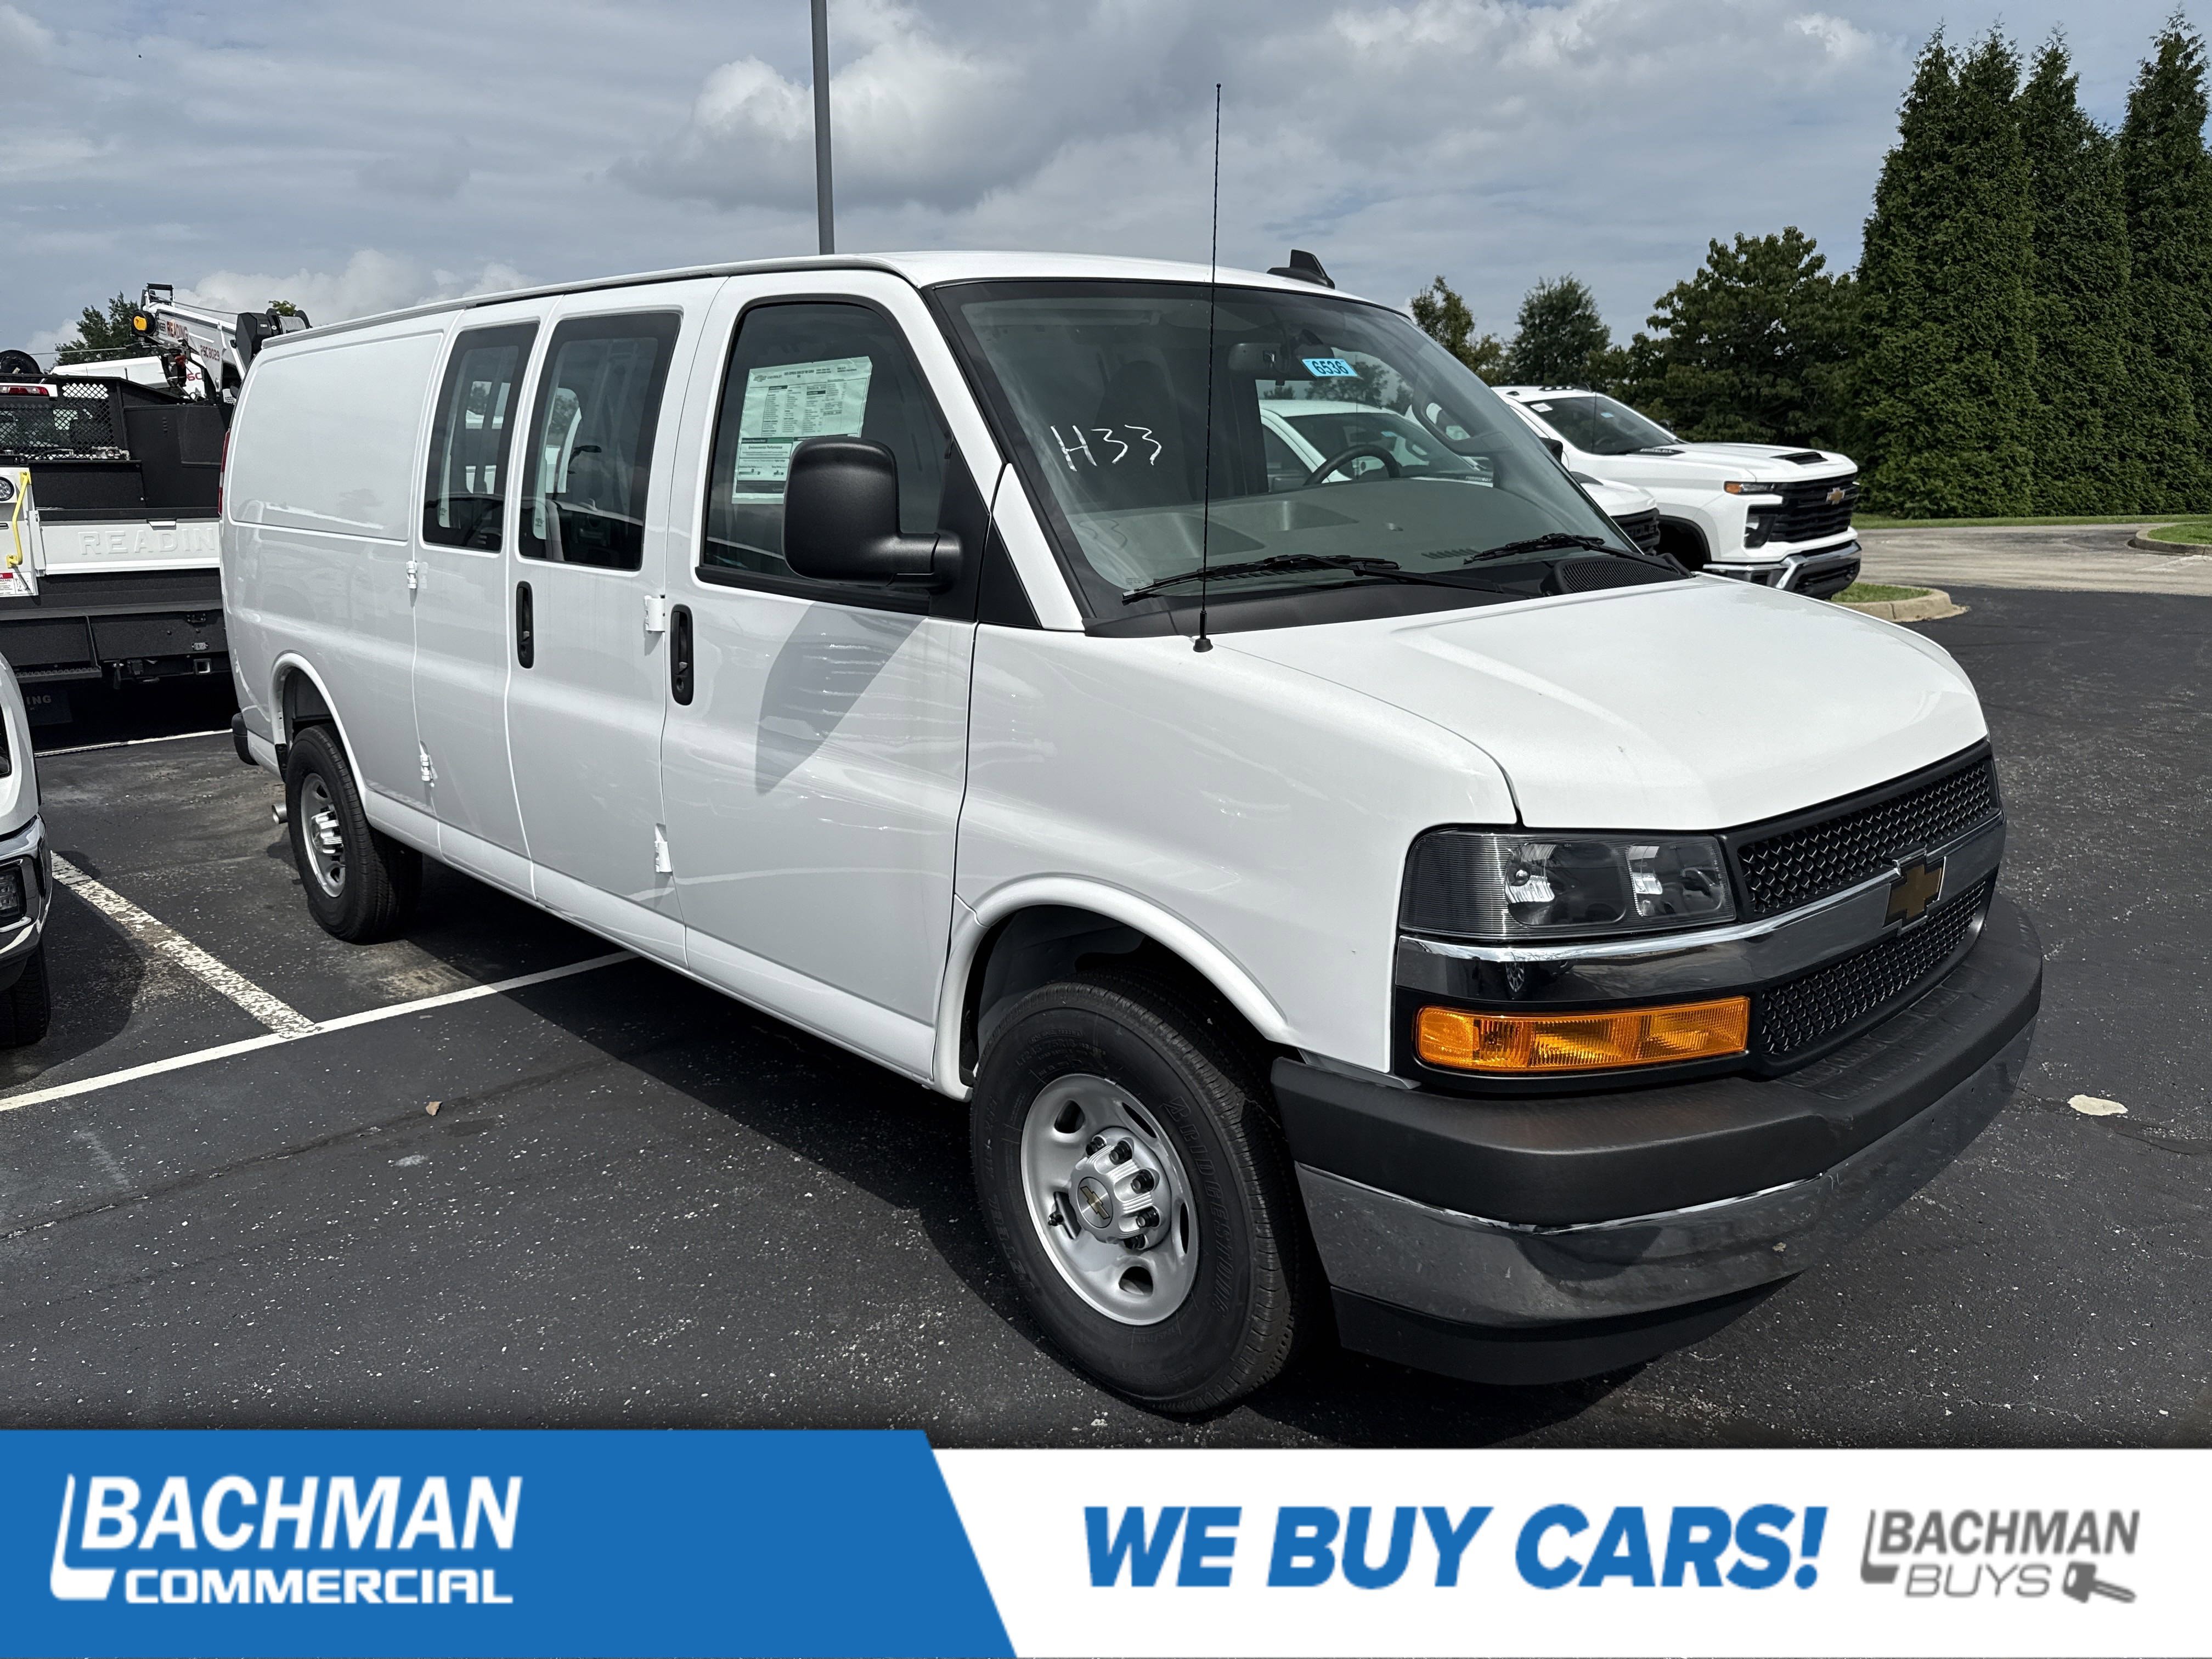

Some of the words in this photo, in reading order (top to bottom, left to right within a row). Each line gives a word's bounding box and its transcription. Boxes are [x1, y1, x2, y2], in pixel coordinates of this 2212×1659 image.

[1312, 360, 1349, 374] 6536
[1050, 425, 1161, 471] H33
[77, 527, 217, 556] READIN
